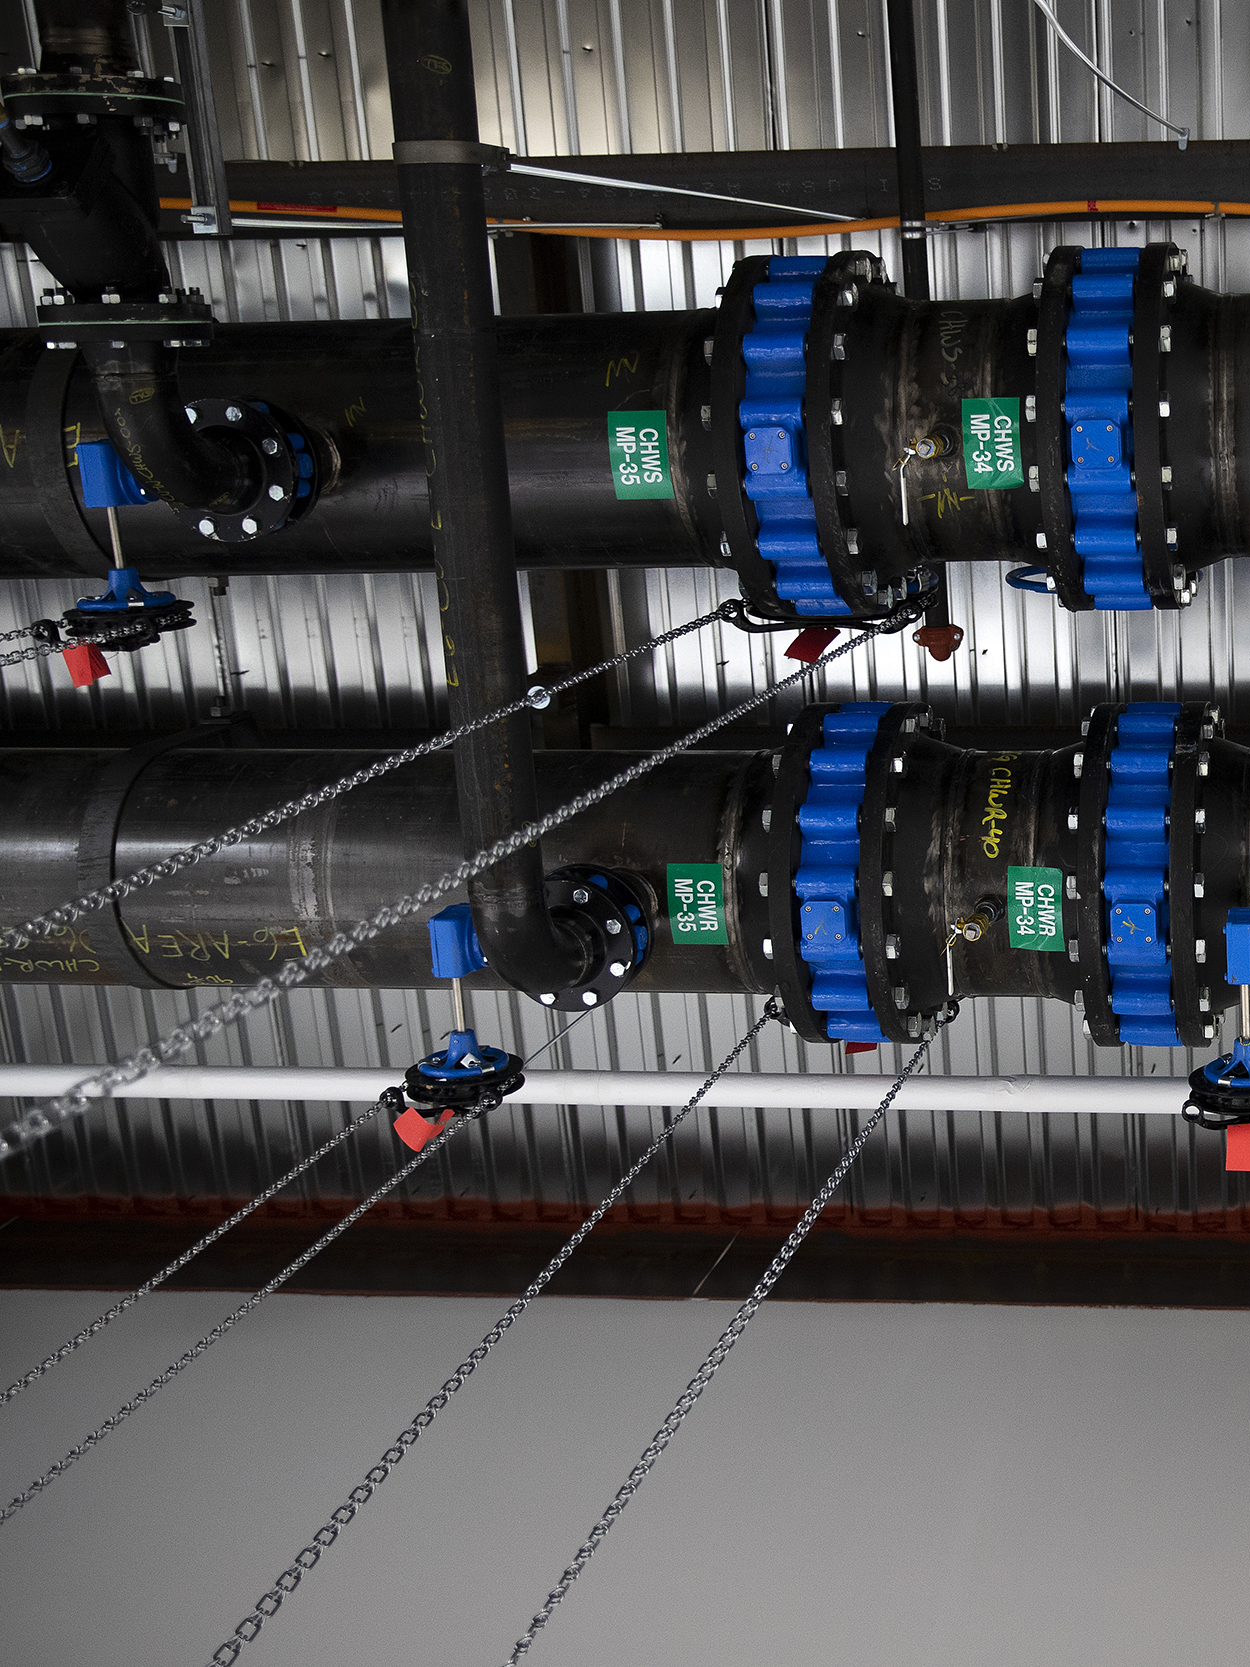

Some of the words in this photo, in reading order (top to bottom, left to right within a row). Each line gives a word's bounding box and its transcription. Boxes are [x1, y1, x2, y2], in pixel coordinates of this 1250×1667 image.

[615, 426, 641, 485] MP-35
[638, 427, 663, 484] CHWS
[969, 413, 993, 474] MP-34
[993, 415, 1015, 472] CHWS
[674, 878, 698, 932] MP-35
[696, 879, 719, 932] CHWR
[1014, 881, 1036, 936] MP-34
[1037, 884, 1056, 937] CHWR
